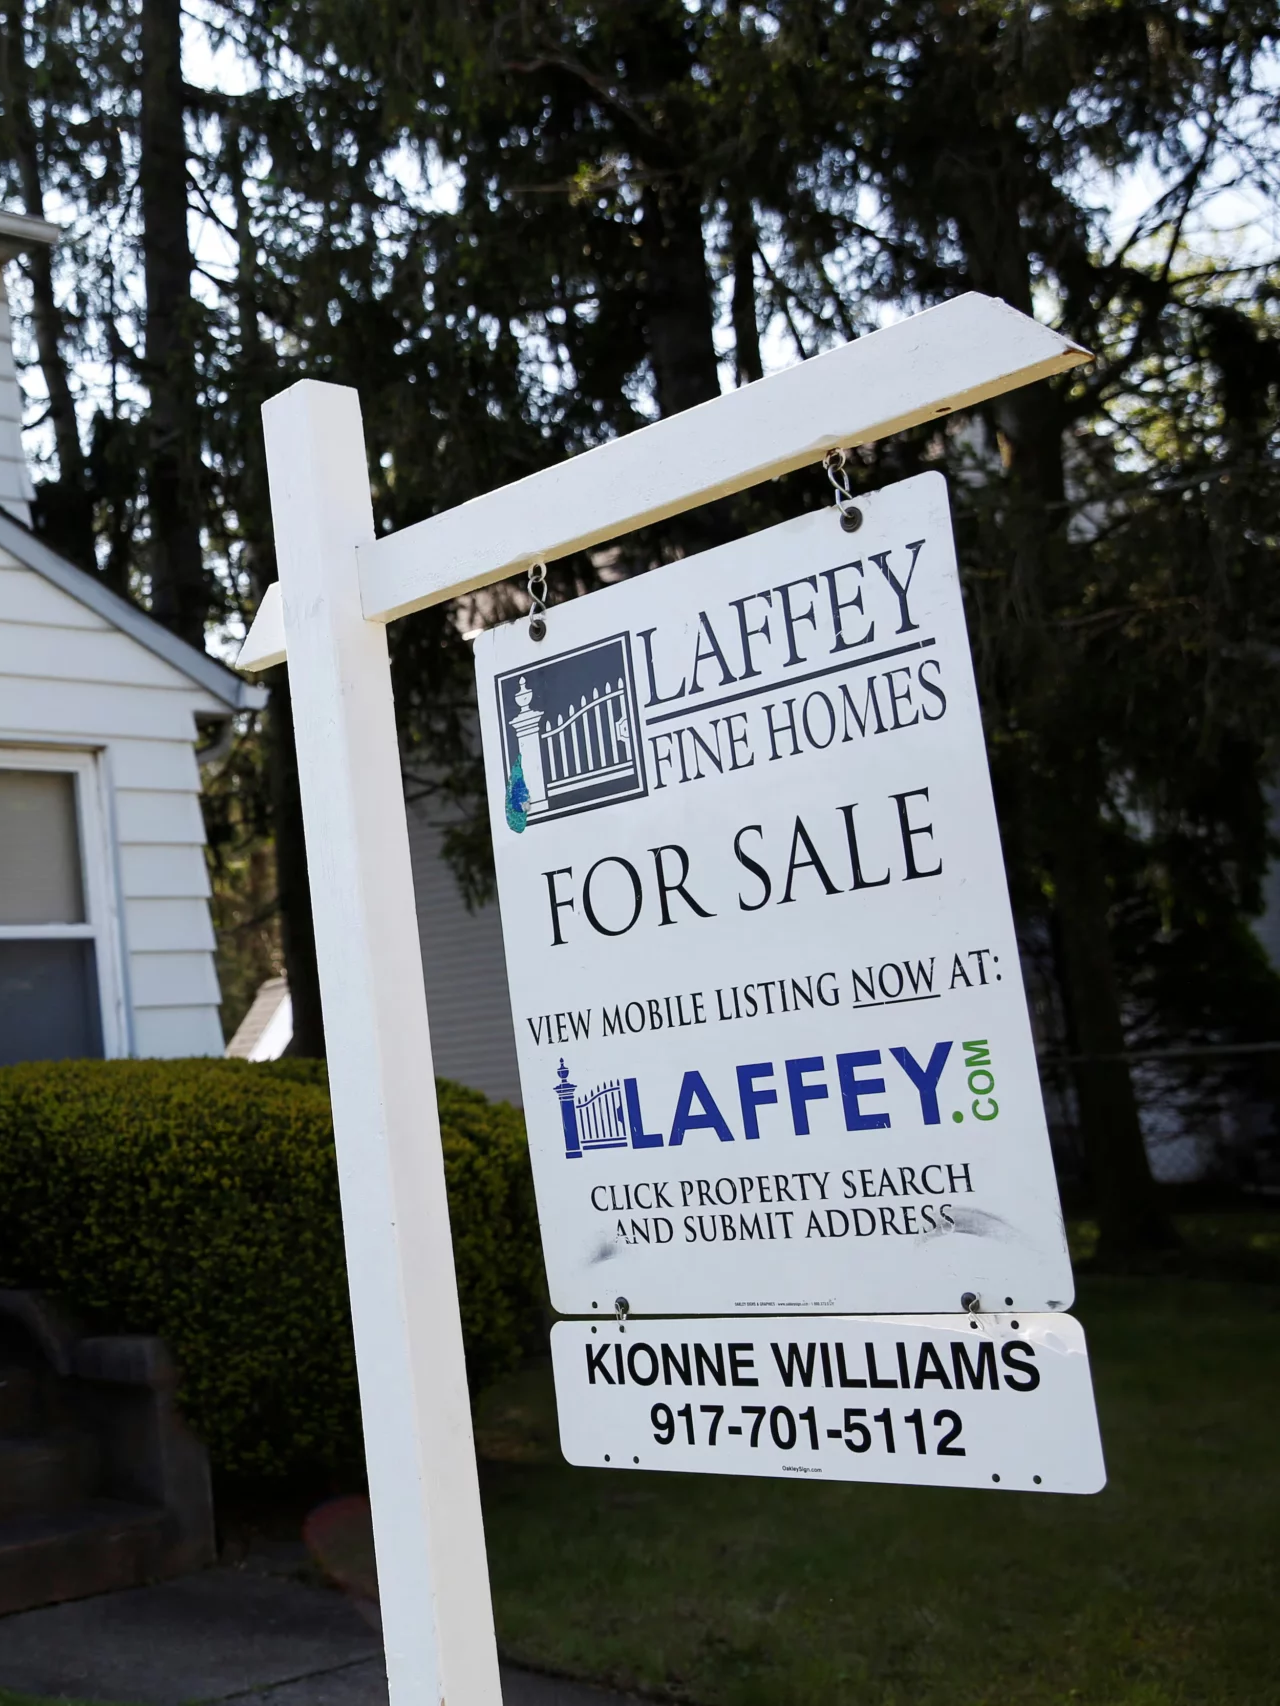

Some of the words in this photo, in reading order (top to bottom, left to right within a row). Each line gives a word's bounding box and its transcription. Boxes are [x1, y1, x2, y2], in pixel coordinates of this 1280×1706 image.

[636, 539, 926, 709] LAFFEY
[648, 712, 755, 790] FINE
[762, 660, 948, 762] HOMES
[541, 845, 718, 947] FOR
[734, 787, 943, 912] SALE
[527, 1009, 592, 1046] VIEW
[603, 992, 707, 1037] MOBILE
[715, 972, 840, 1021] LISTING
[852, 957, 937, 1004] NOW
[949, 949, 1003, 990] AT:
[591, 1181, 675, 1212] CLICK
[680, 1172, 831, 1207] PROPERTY
[842, 1163, 975, 1199] SEARCH
[615, 1217, 674, 1245] AND
[684, 1212, 794, 1243] SUBMIT
[805, 1203, 956, 1239] ADDRESS
[586, 1343, 760, 1388] KIONNE
[770, 1340, 1041, 1393] WILLIAMS
[651, 1403, 967, 1457] 917-701-5112
[781, 1465, 823, 1474] OakleySign.com
